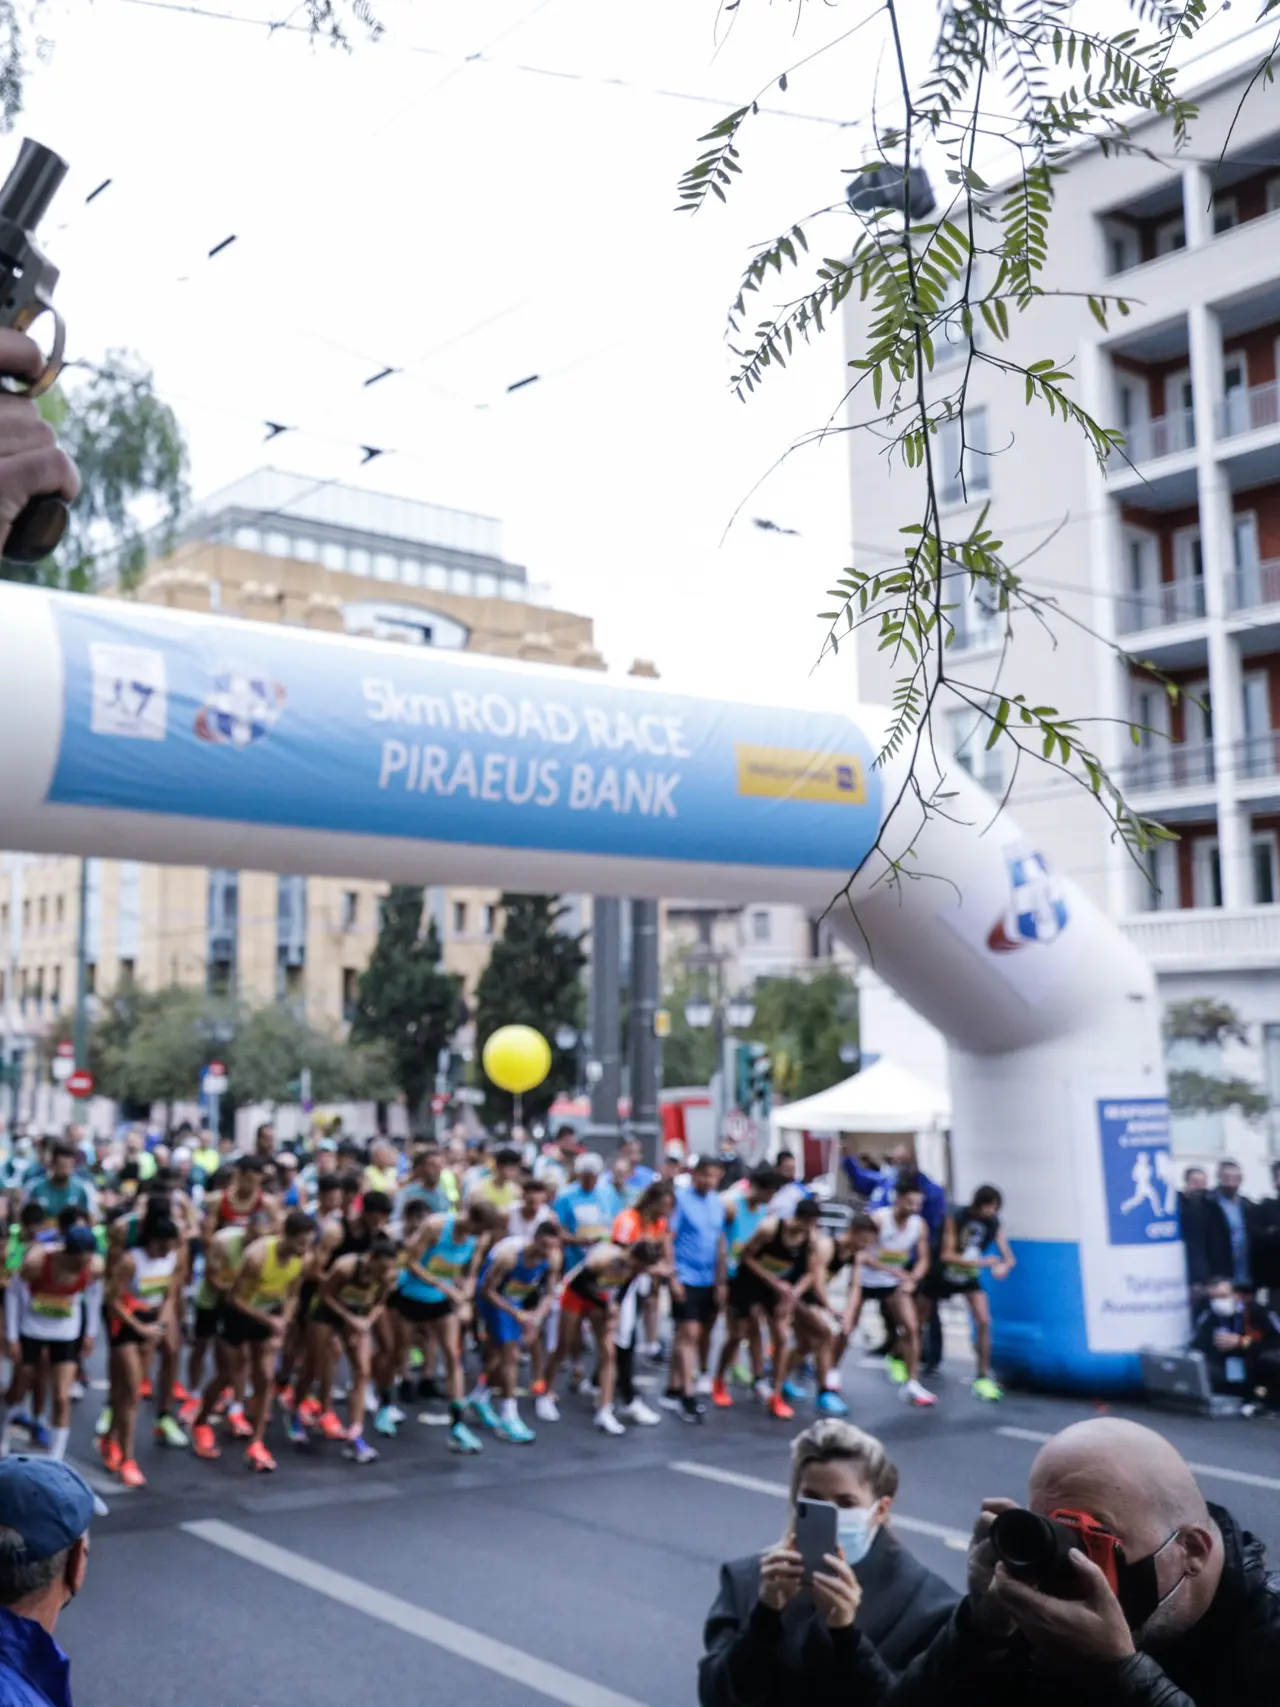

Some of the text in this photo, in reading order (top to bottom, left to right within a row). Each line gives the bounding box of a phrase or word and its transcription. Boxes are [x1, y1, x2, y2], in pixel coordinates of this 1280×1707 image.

[362, 677, 692, 759] 5km ROAD RACE
[377, 739, 681, 818] PIRAEUS BANK
